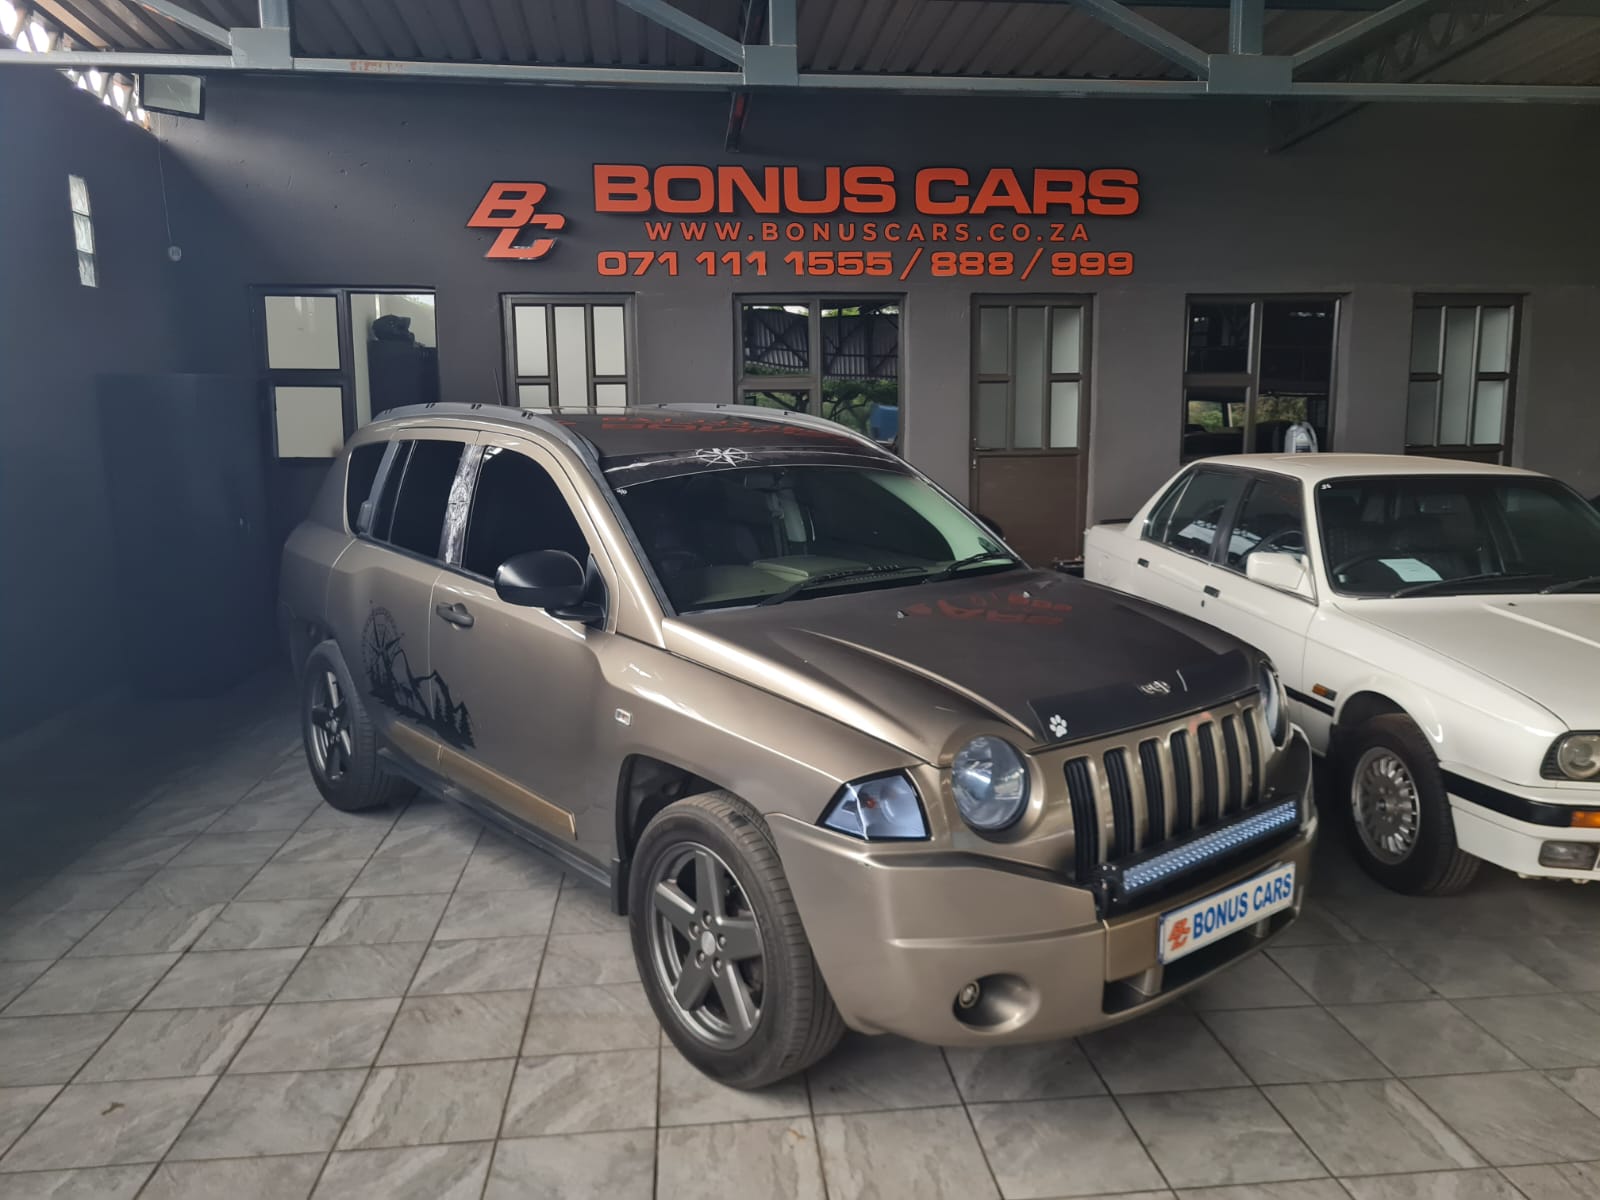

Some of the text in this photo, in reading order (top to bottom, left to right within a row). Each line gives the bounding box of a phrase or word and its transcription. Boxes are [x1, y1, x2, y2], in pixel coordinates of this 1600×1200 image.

[593, 164, 1140, 215] BONUS CARS
[645, 223, 1090, 242] WWW.BONUSCARS.CO.ZA
[597, 251, 678, 277] 071
[695, 251, 767, 277] 111
[1193, 892, 1248, 939] BONUS
[1253, 873, 1292, 911] CARS
